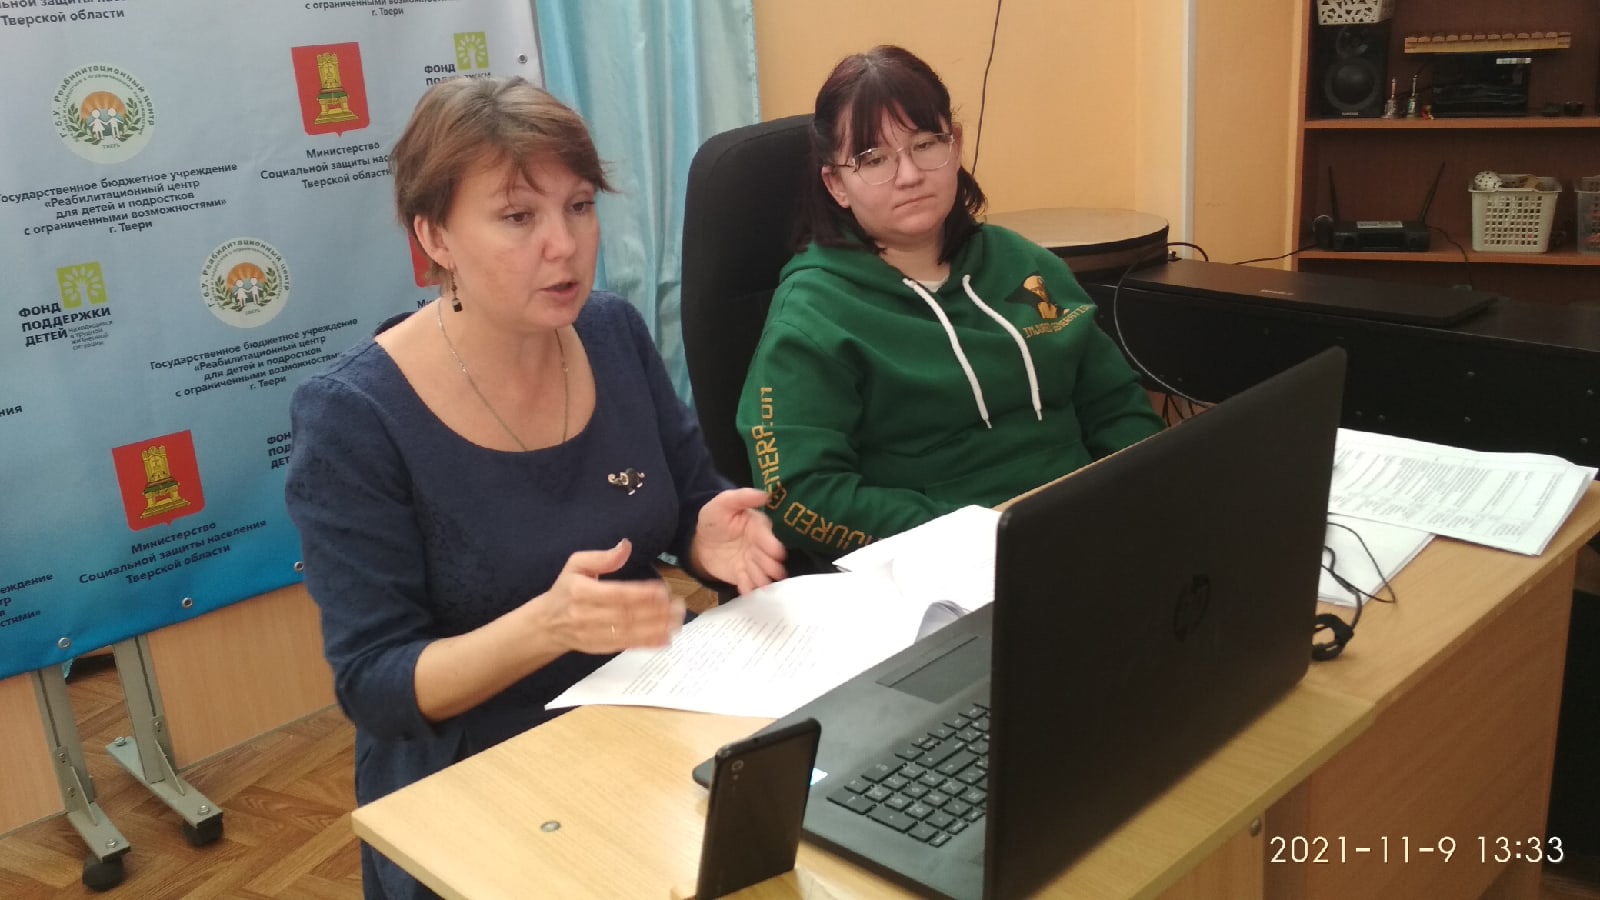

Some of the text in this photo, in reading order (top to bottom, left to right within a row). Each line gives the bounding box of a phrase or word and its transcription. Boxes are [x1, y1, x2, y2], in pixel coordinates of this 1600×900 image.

[0, 0, 37, 9] ьной
[0, 9, 125, 28] Тверской области
[424, 63, 456, 73] ФОНД
[306, 142, 380, 159] Министерство
[101, 173, 167, 188] бюджетное
[169, 164, 238, 181] учреждение
[260, 154, 390, 180] Социальной защиты нас
[301, 174, 350, 188] Тверской
[44, 180, 200, 208] «Реабилитационный центр
[56, 208, 78, 220] для
[81, 202, 115, 216] детей
[128, 192, 195, 207] подростков
[24, 199, 227, 235] с ограниченными возможностями»
[118, 221, 152, 232] Твери
[19, 302, 61, 317] ФОНД
[22, 307, 111, 332] ПОДДЕРЖКИ
[25, 327, 68, 347] ДЕТЕЙ
[150, 318, 358, 370] Государственное бюджетное учреждение
[194, 336, 326, 371] «Реабилитационный центр
[204, 370, 223, 382] для
[226, 361, 255, 376] детей
[267, 347, 322, 365] подростков
[184, 370, 266, 395] ограниченными
[268, 352, 342, 375] возможностям
[258, 376, 286, 388] Твери
[267, 431, 292, 445] ФОН
[268, 444, 291, 456] ПОД
[271, 456, 290, 469] ДЕТ
[131, 522, 217, 554] Министерство
[79, 520, 267, 583] Социальной защиты населения
[125, 544, 231, 584] Тверской области
